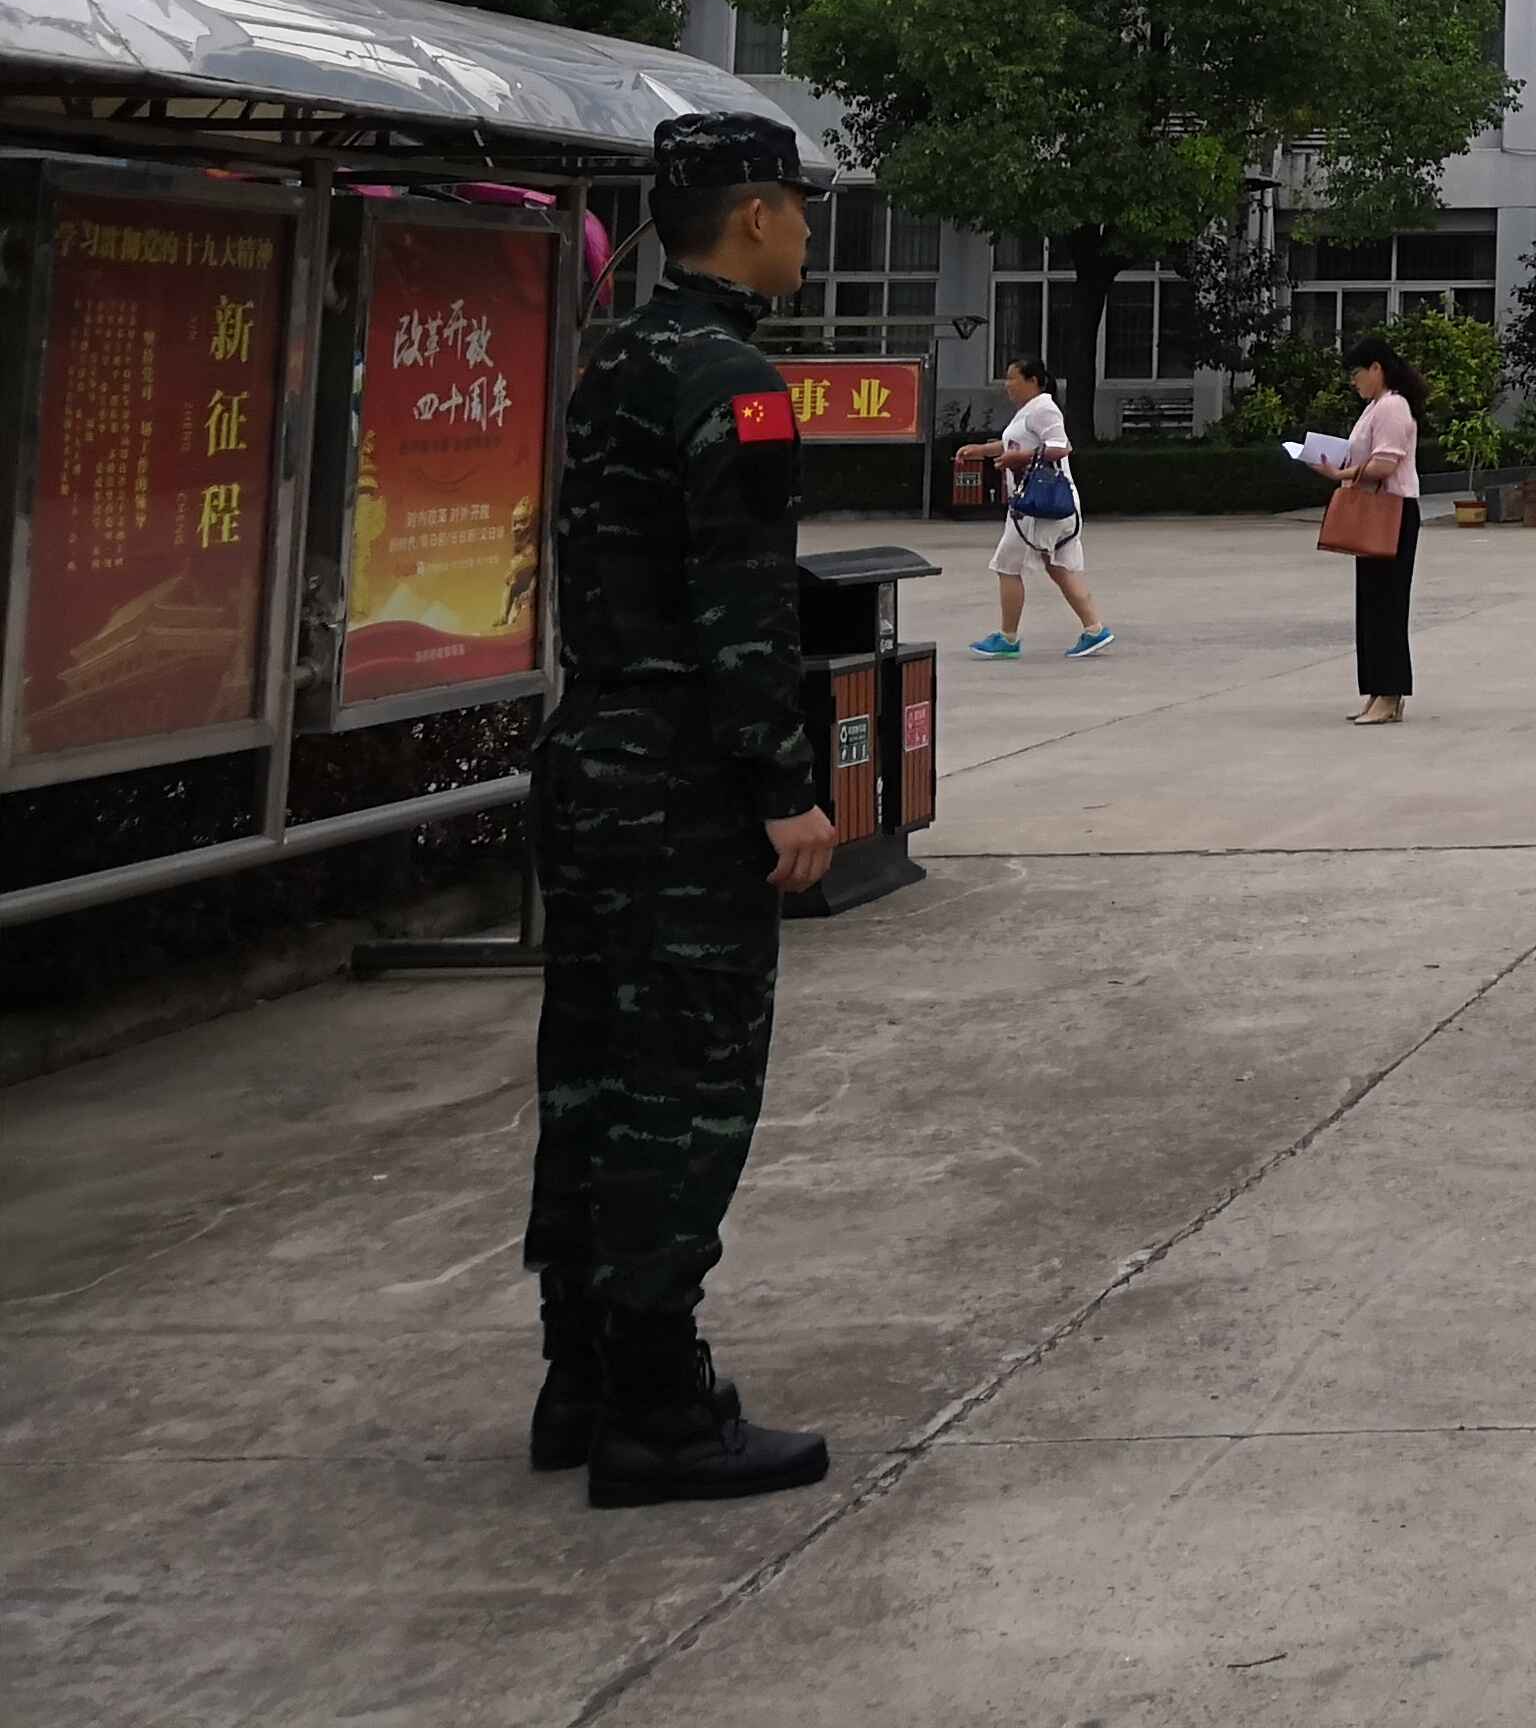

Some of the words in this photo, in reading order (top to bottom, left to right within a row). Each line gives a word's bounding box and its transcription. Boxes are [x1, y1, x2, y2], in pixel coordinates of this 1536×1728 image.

[393, 299, 494, 369] 改革开放
[197, 295, 255, 549] 新征程
[413, 372, 512, 432] 四十周年
[787, 378, 891, 422] 事业
